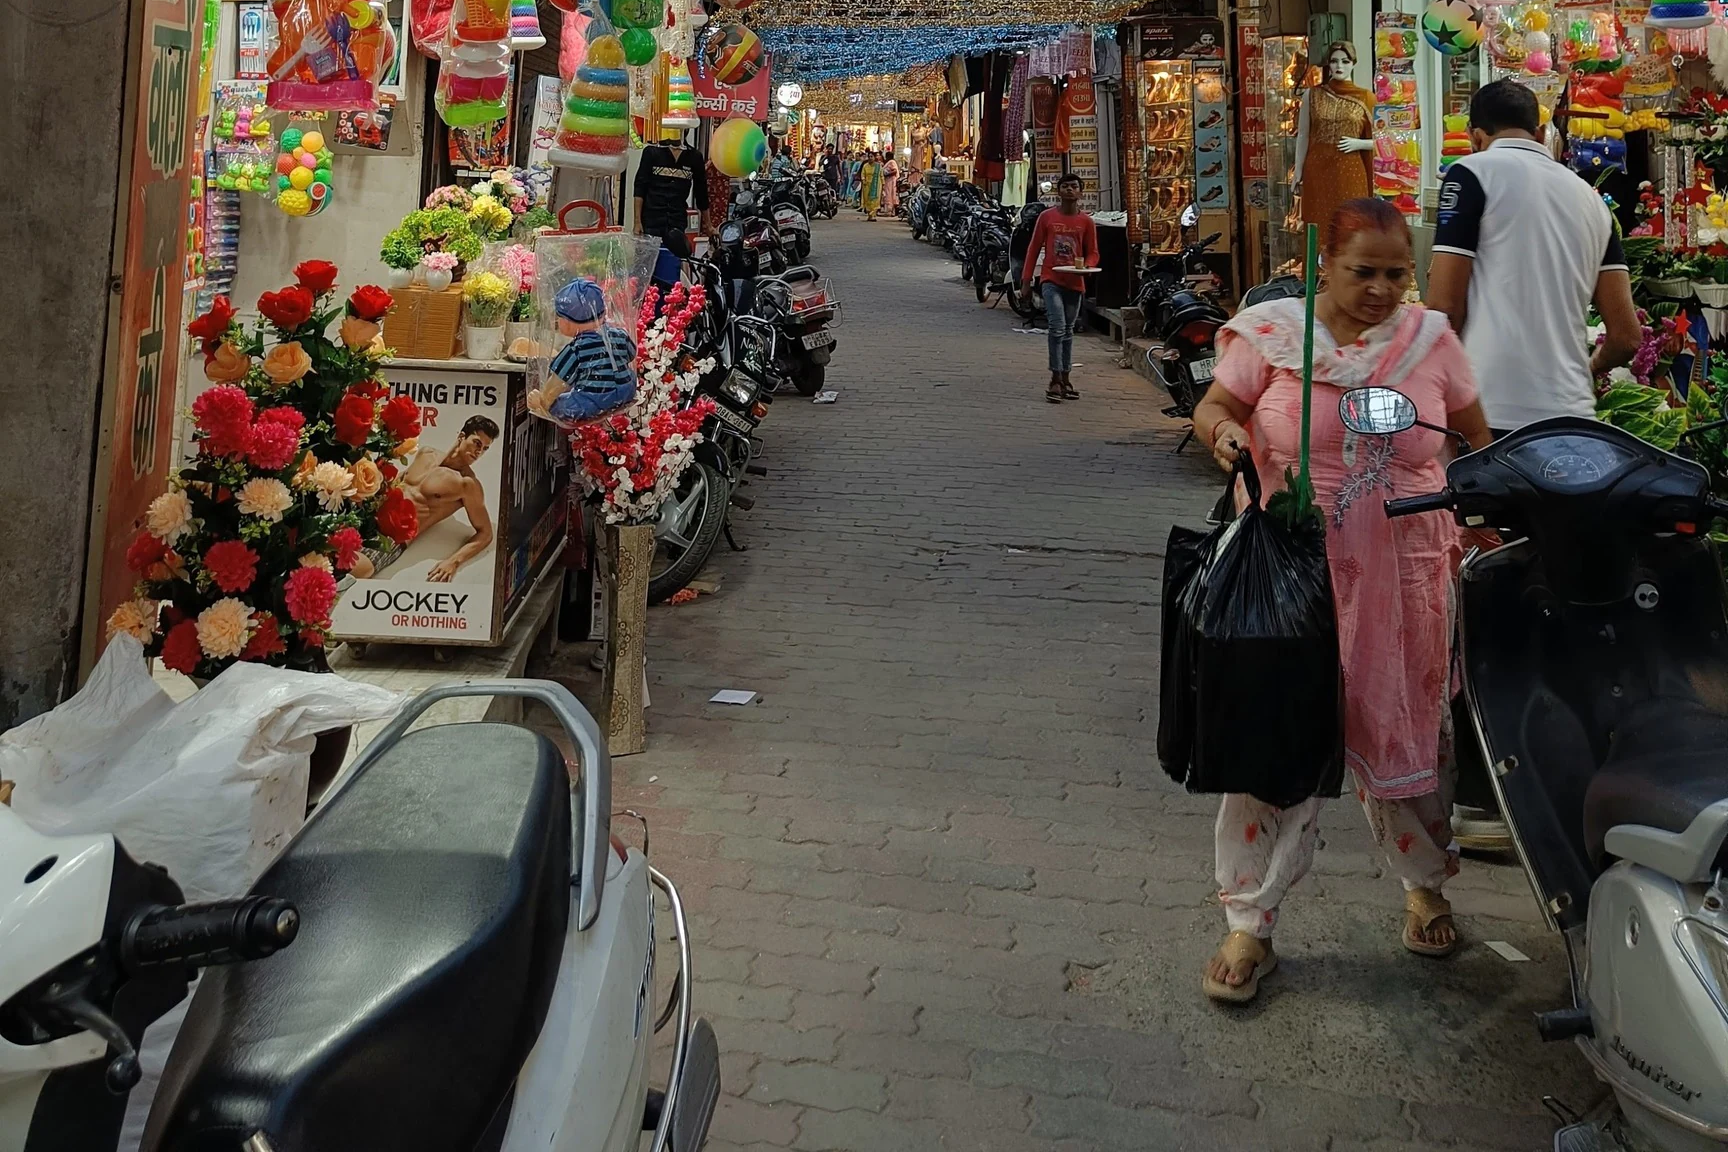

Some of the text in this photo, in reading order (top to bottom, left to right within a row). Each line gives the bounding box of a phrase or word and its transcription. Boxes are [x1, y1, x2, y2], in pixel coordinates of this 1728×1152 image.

[387, 382, 497, 406] THING FITS
[352, 589, 469, 614] JOCKEY
[391, 614, 467, 629] OR NOTHING
